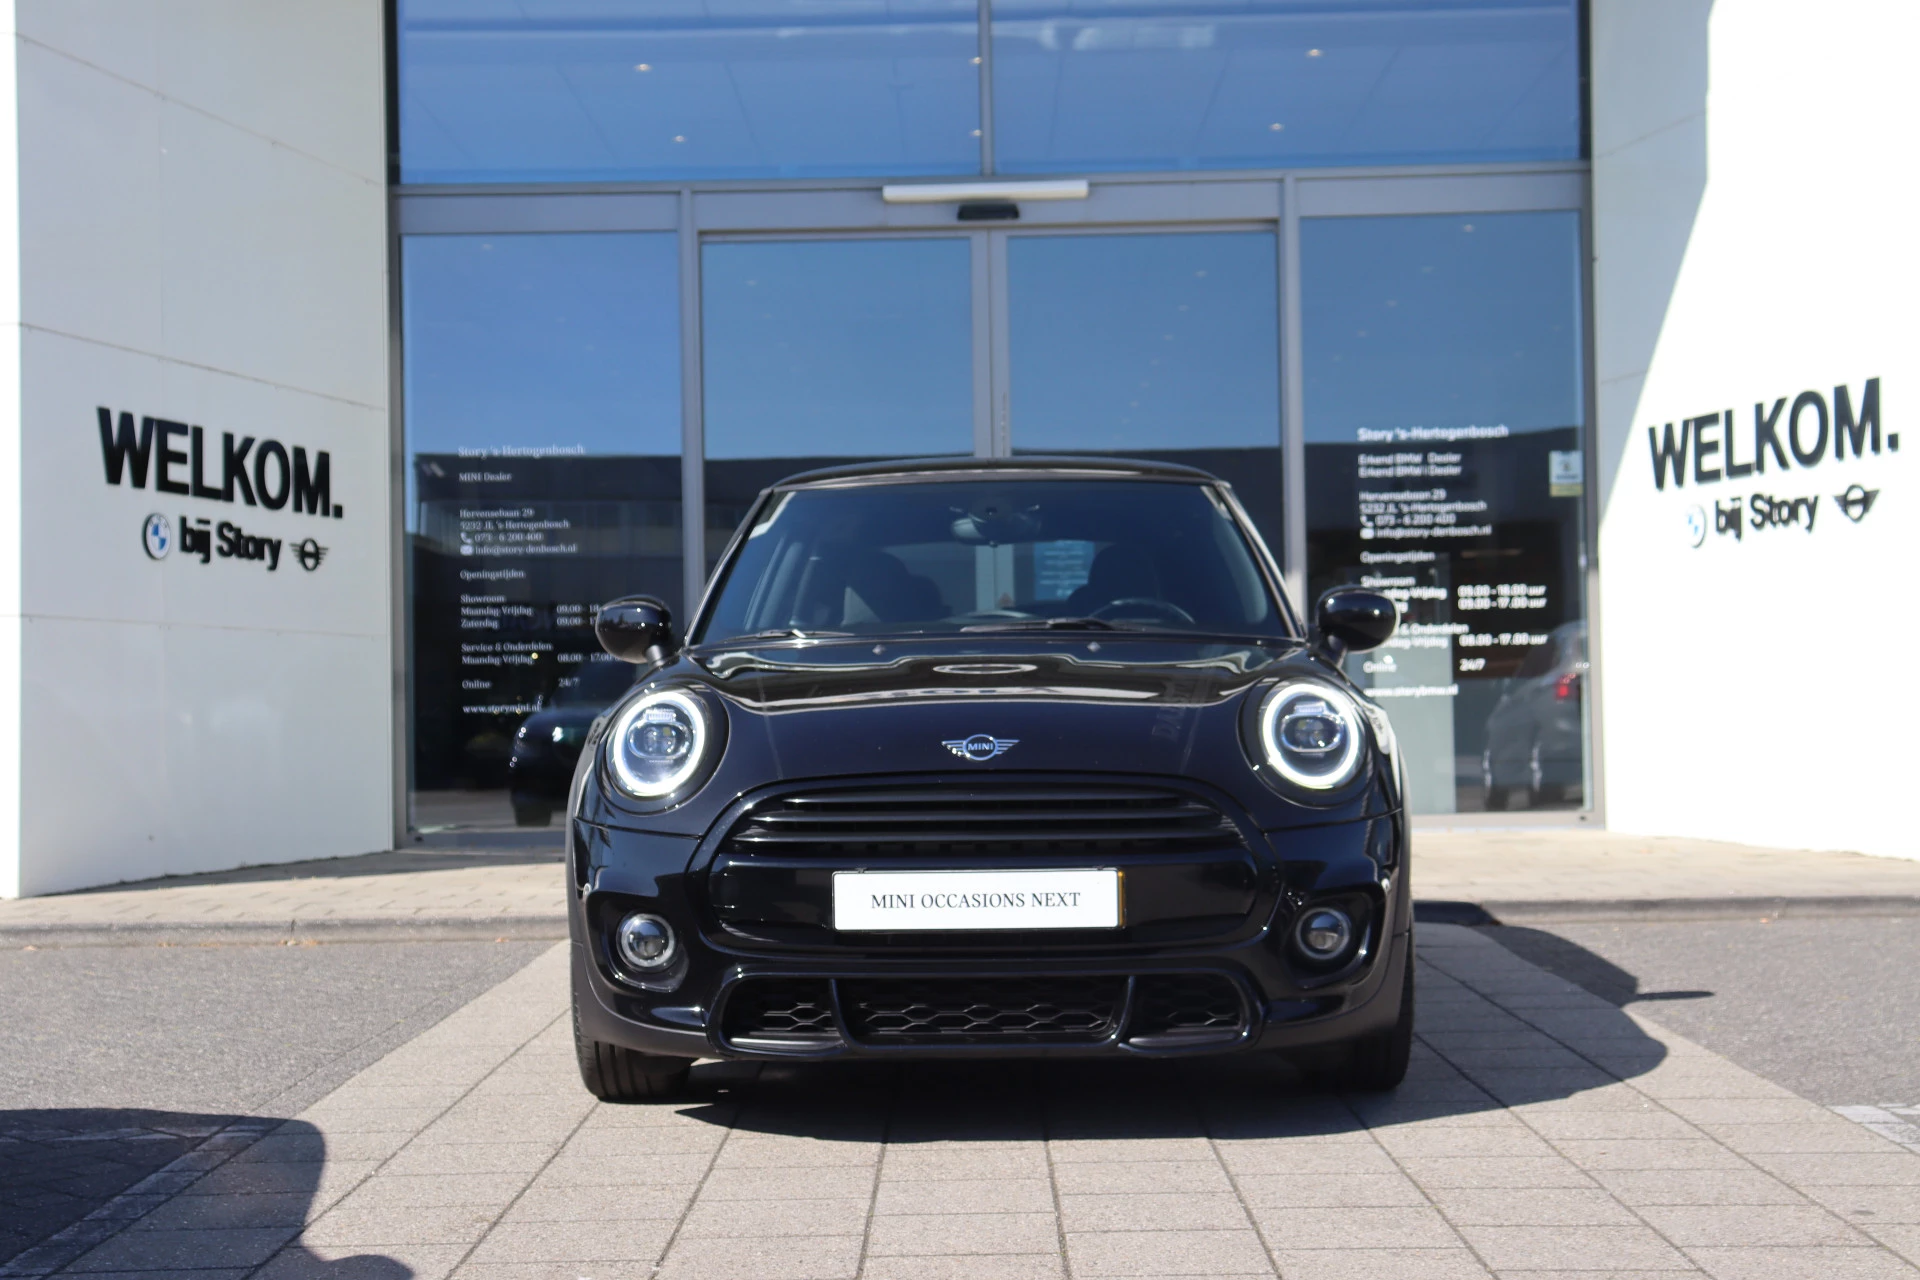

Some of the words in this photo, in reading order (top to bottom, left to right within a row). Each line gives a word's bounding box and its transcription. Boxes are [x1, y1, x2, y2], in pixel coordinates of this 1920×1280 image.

[1357, 427, 1393, 443] Story
[1648, 376, 1899, 492] WELKOM.
[458, 446, 487, 460] Story
[1427, 452, 1461, 464] Dealer
[97, 406, 343, 518] WELKOM.
[1428, 464, 1461, 476] Dealer
[459, 472, 481, 482] MINI
[483, 471, 512, 481] Dealer
[1750, 493, 1819, 533] Story
[216, 521, 282, 571] Story
[460, 569, 525, 580] Openingstijden
[1361, 576, 1415, 588] Showroom
[460, 594, 505, 603] Showroom
[460, 618, 499, 629] Zaterdag
[461, 643, 493, 652] Service
[461, 679, 491, 689] Online
[967, 743, 993, 751] MINI
[871, 894, 914, 909] MINI
[921, 893, 1026, 908] OCCASIONS
[1031, 892, 1081, 907] NEXT
